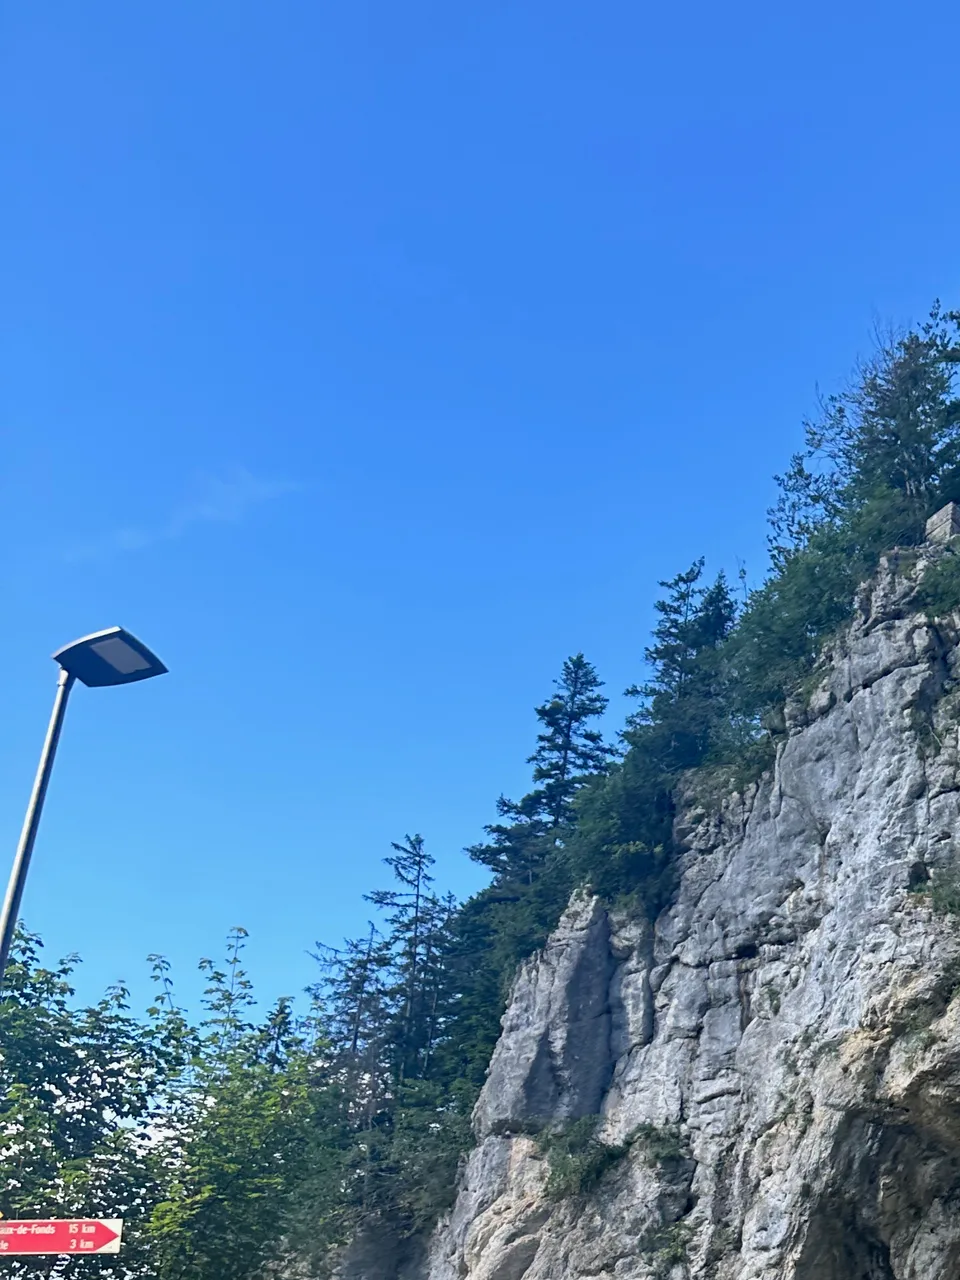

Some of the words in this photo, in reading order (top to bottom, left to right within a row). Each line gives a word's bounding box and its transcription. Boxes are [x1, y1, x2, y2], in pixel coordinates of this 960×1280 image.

[68, 1224, 78, 1234] 15
[82, 1224, 95, 1233] km
[69, 1239, 77, 1249] 3
[80, 1239, 94, 1248] km
